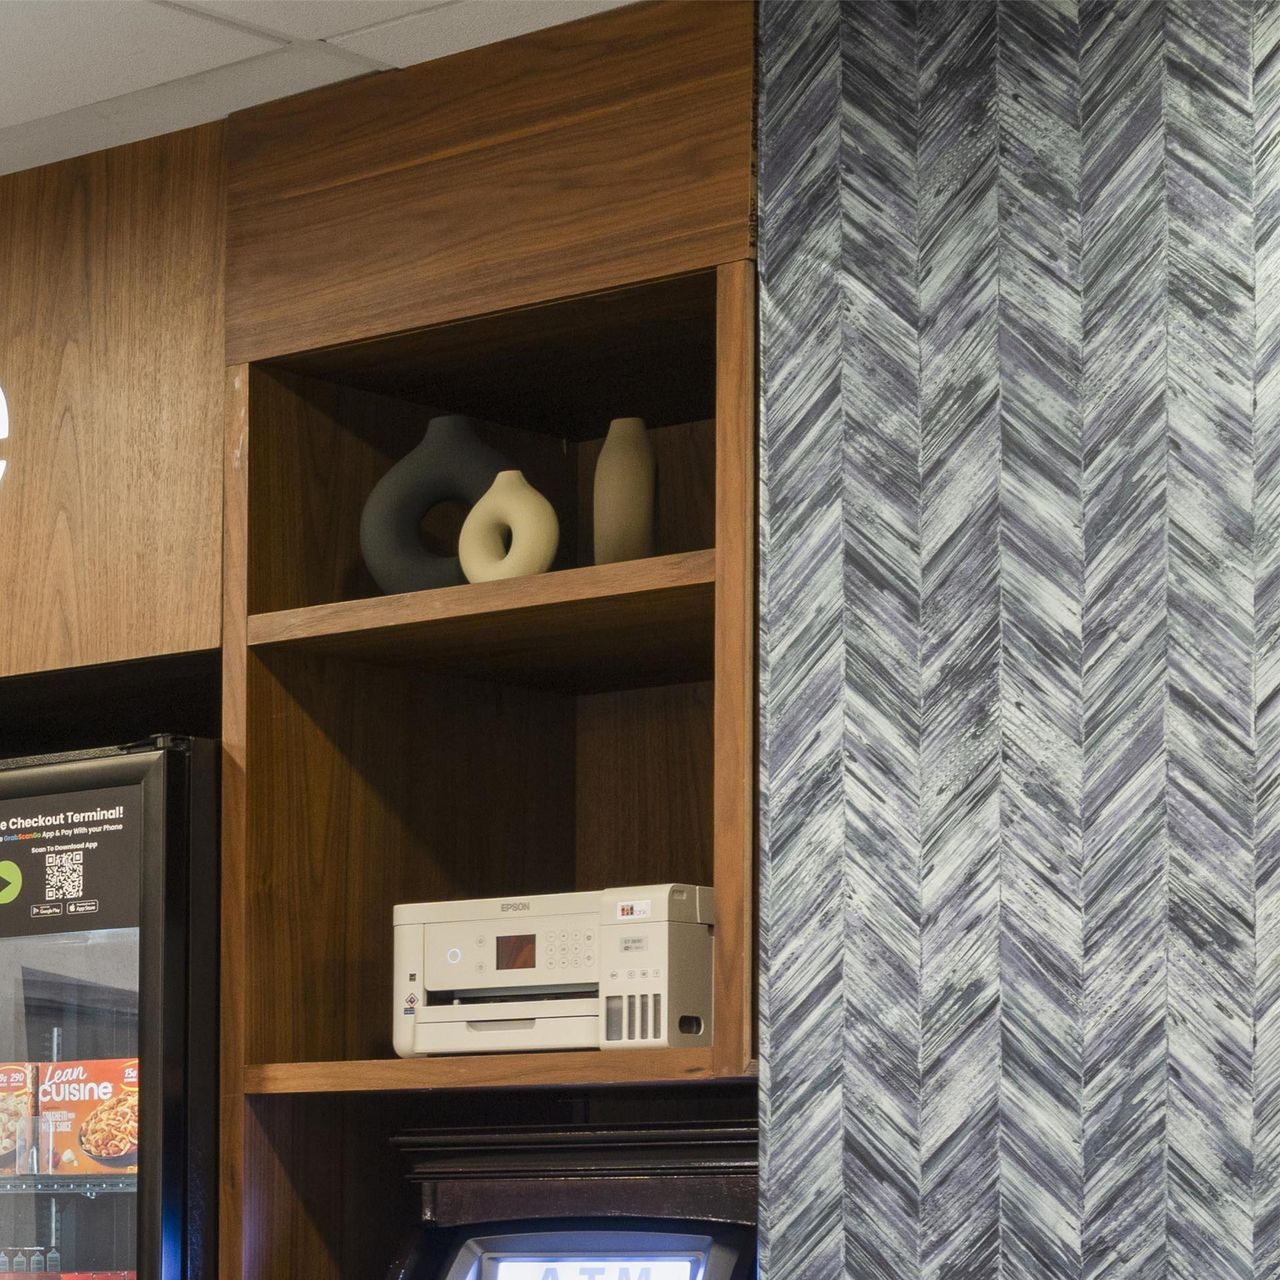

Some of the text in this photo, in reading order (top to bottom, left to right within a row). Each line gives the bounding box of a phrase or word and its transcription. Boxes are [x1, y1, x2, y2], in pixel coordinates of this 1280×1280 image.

[9, 814, 65, 829] Checkout
[66, 806, 124, 824] Terminal!
[42, 831, 54, 839] App
[61, 829, 72, 837] Pay
[74, 826, 87, 835] With
[88, 826, 102, 834] your
[103, 823, 123, 831] Phone
[31, 846, 46, 854] Scan
[54, 842, 84, 851] Download
[85, 841, 98, 850] App
[501, 902, 530, 912] EPSON
[45, 1065, 88, 1090] Lean
